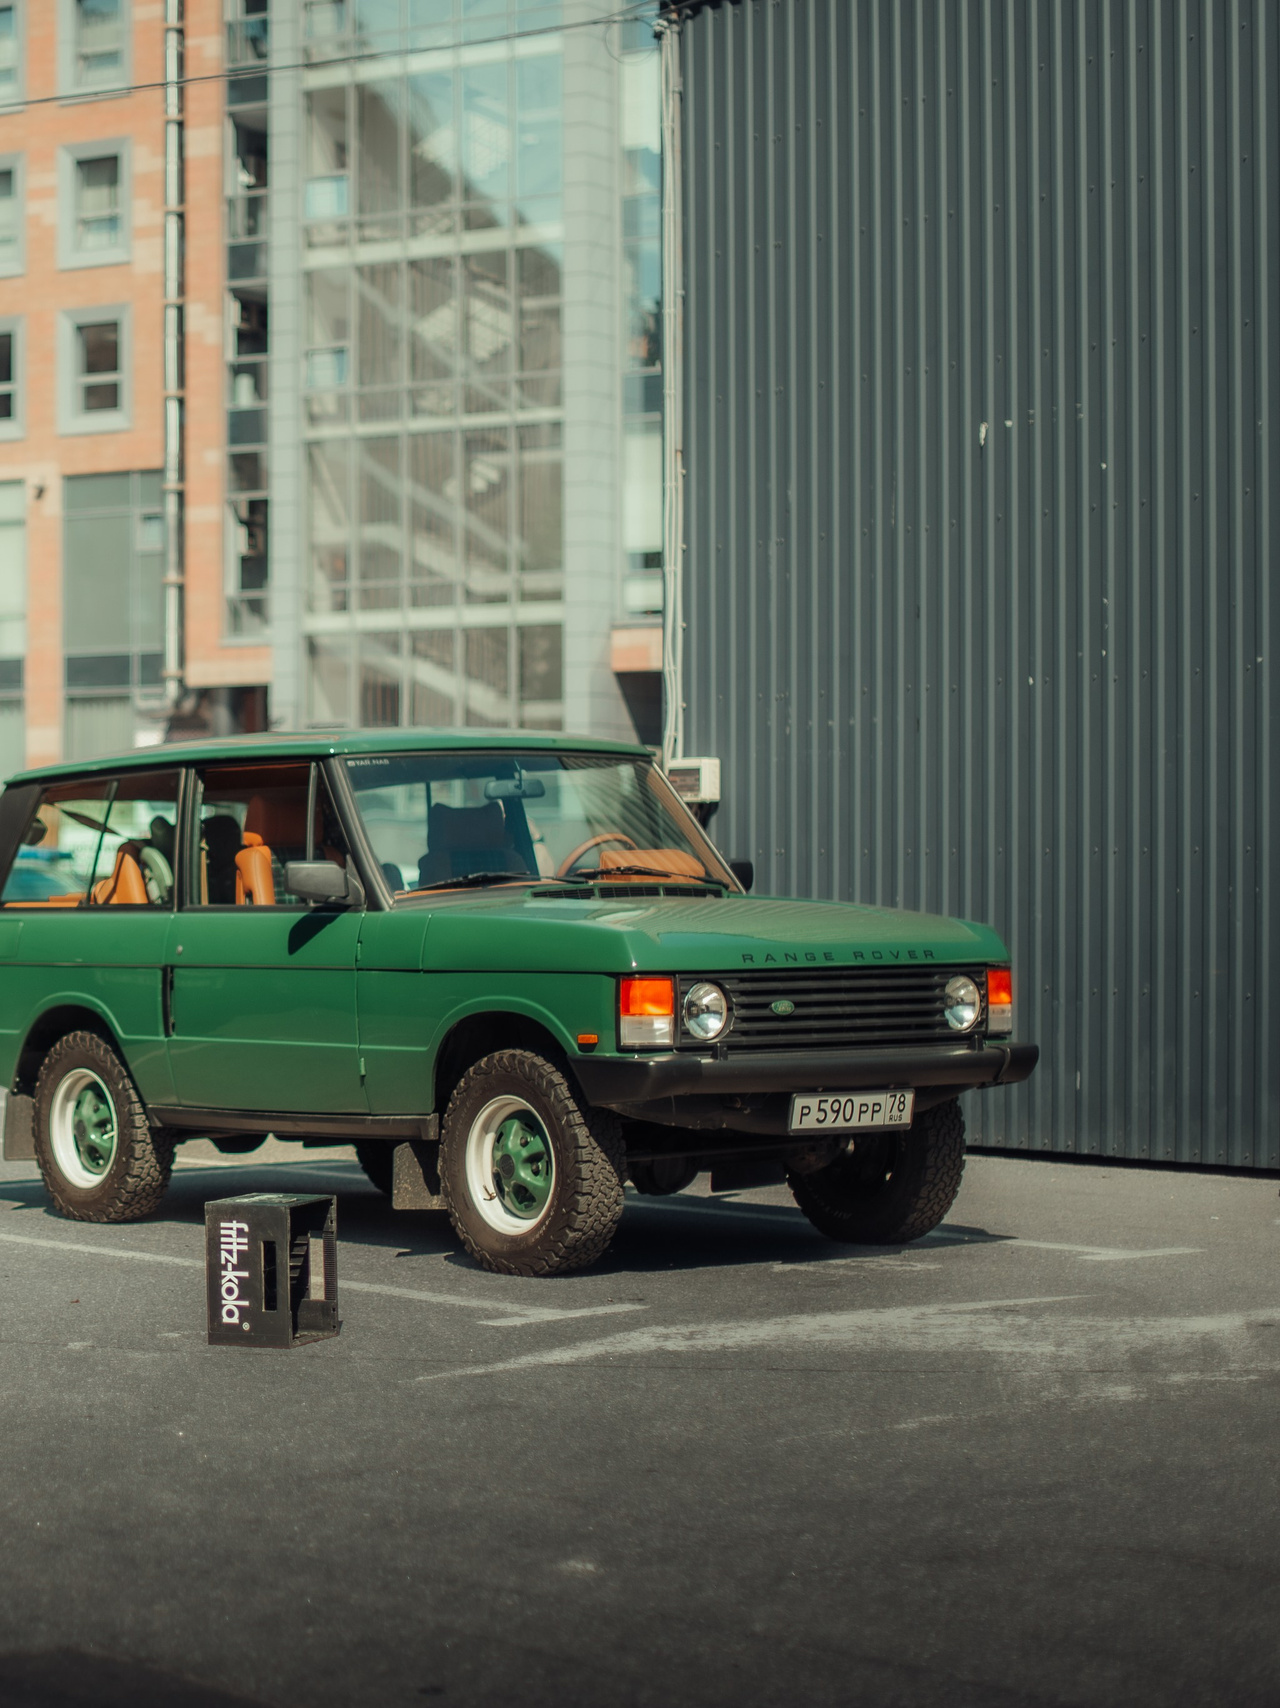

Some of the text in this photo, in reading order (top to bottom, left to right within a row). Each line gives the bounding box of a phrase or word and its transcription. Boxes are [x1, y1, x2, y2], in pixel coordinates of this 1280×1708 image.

[741, 949, 936, 964] RANGE ROVER
[888, 1090, 906, 1113] 78
[888, 1113, 903, 1122] RUS
[220, 1220, 250, 1324] fritz-kola
